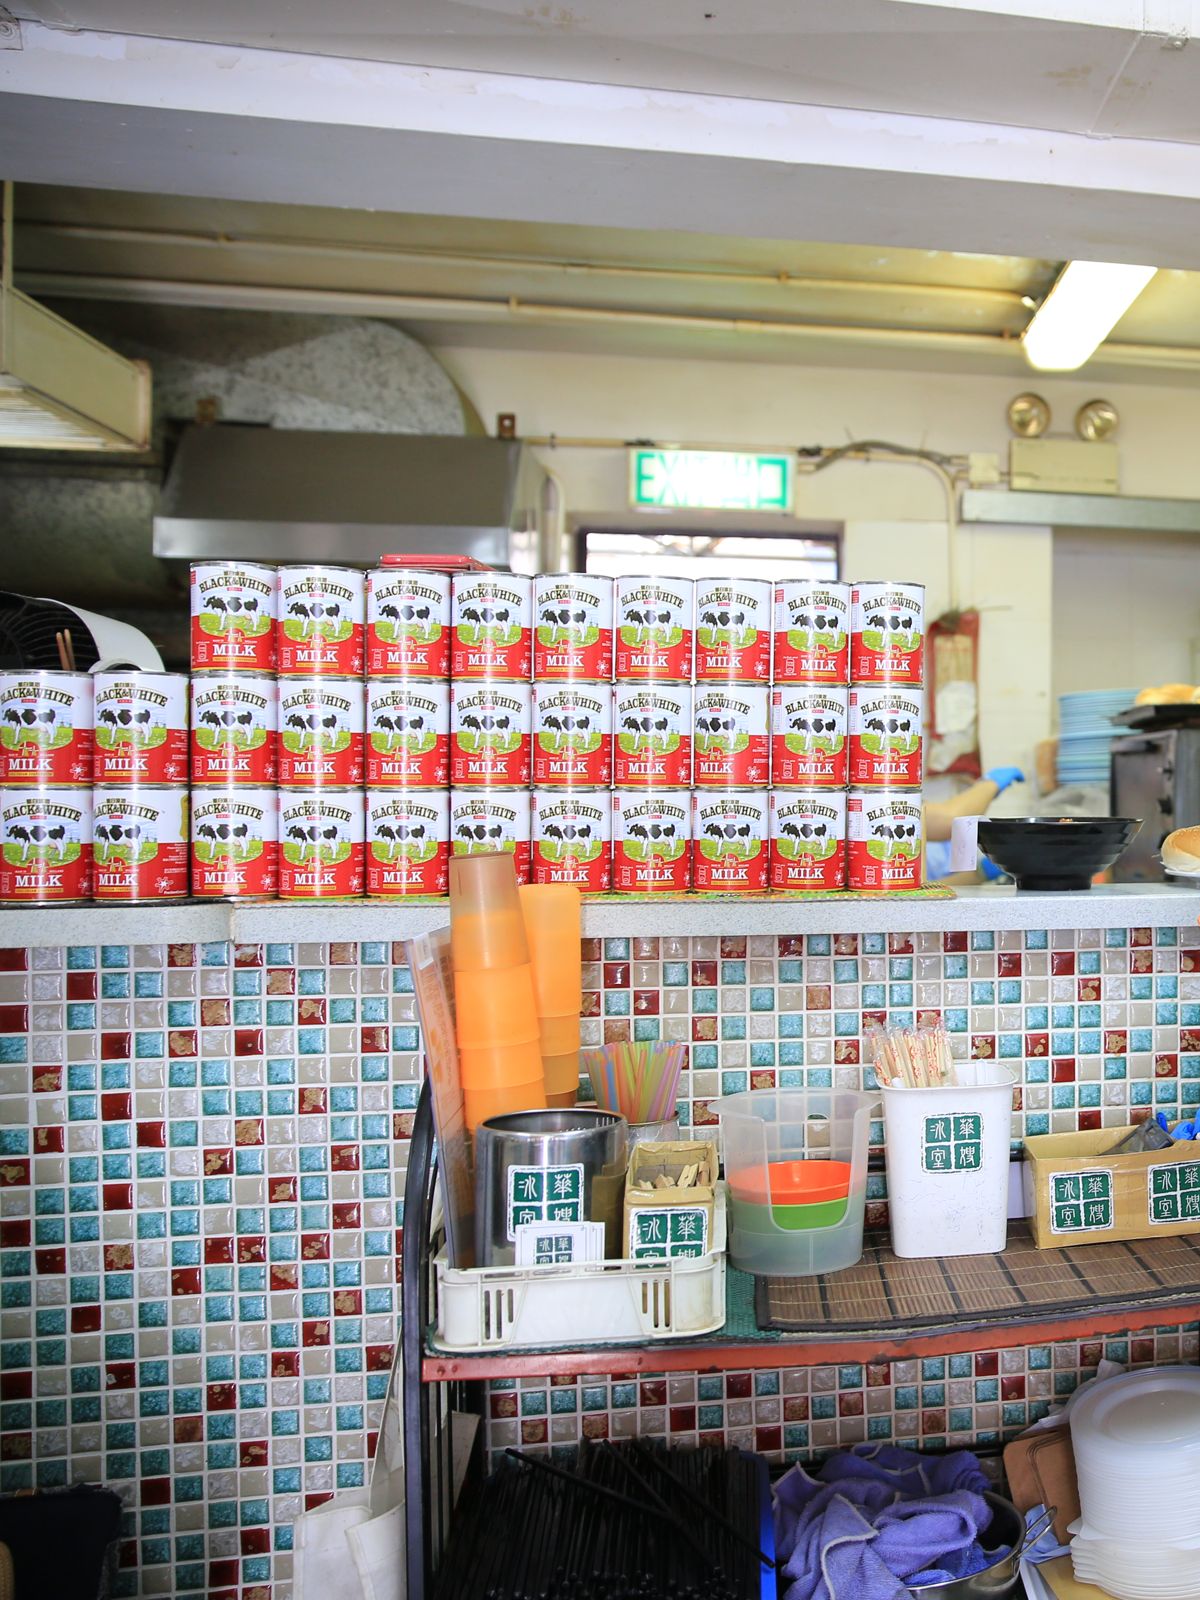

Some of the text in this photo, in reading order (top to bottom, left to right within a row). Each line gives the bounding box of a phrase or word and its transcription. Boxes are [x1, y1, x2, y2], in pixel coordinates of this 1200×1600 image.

[213, 644, 257, 656] MILK
[296, 650, 338, 662] MILK
[387, 652, 428, 663] MILK
[468, 654, 507, 665] MILK
[546, 655, 584, 667] MILK
[631, 655, 669, 667] MILK
[706, 657, 742, 668] MILK
[801, 660, 836, 671] MILK
[875, 660, 910, 671] MILK
[8, 759, 53, 771] MILK
[105, 759, 148, 771] MILK
[207, 758, 250, 770] MILK
[294, 762, 335, 773] MILK
[381, 762, 422, 774] MILK
[468, 761, 507, 773] MILK
[550, 761, 588, 773] MILK
[628, 762, 666, 774] MILK
[700, 762, 732, 773] MILK
[798, 763, 834, 774] MILK
[874, 763, 909, 774] MILK
[204, 872, 246, 883] MILK
[294, 873, 336, 885] MILK
[383, 871, 423, 883] MILK
[550, 870, 589, 881] MILK
[636, 869, 673, 881] MILK
[711, 868, 748, 880] MILK
[787, 867, 824, 879] MILK
[881, 867, 914, 879] MILK
[15, 875, 63, 887] MILK
[98, 873, 138, 886] MILK
